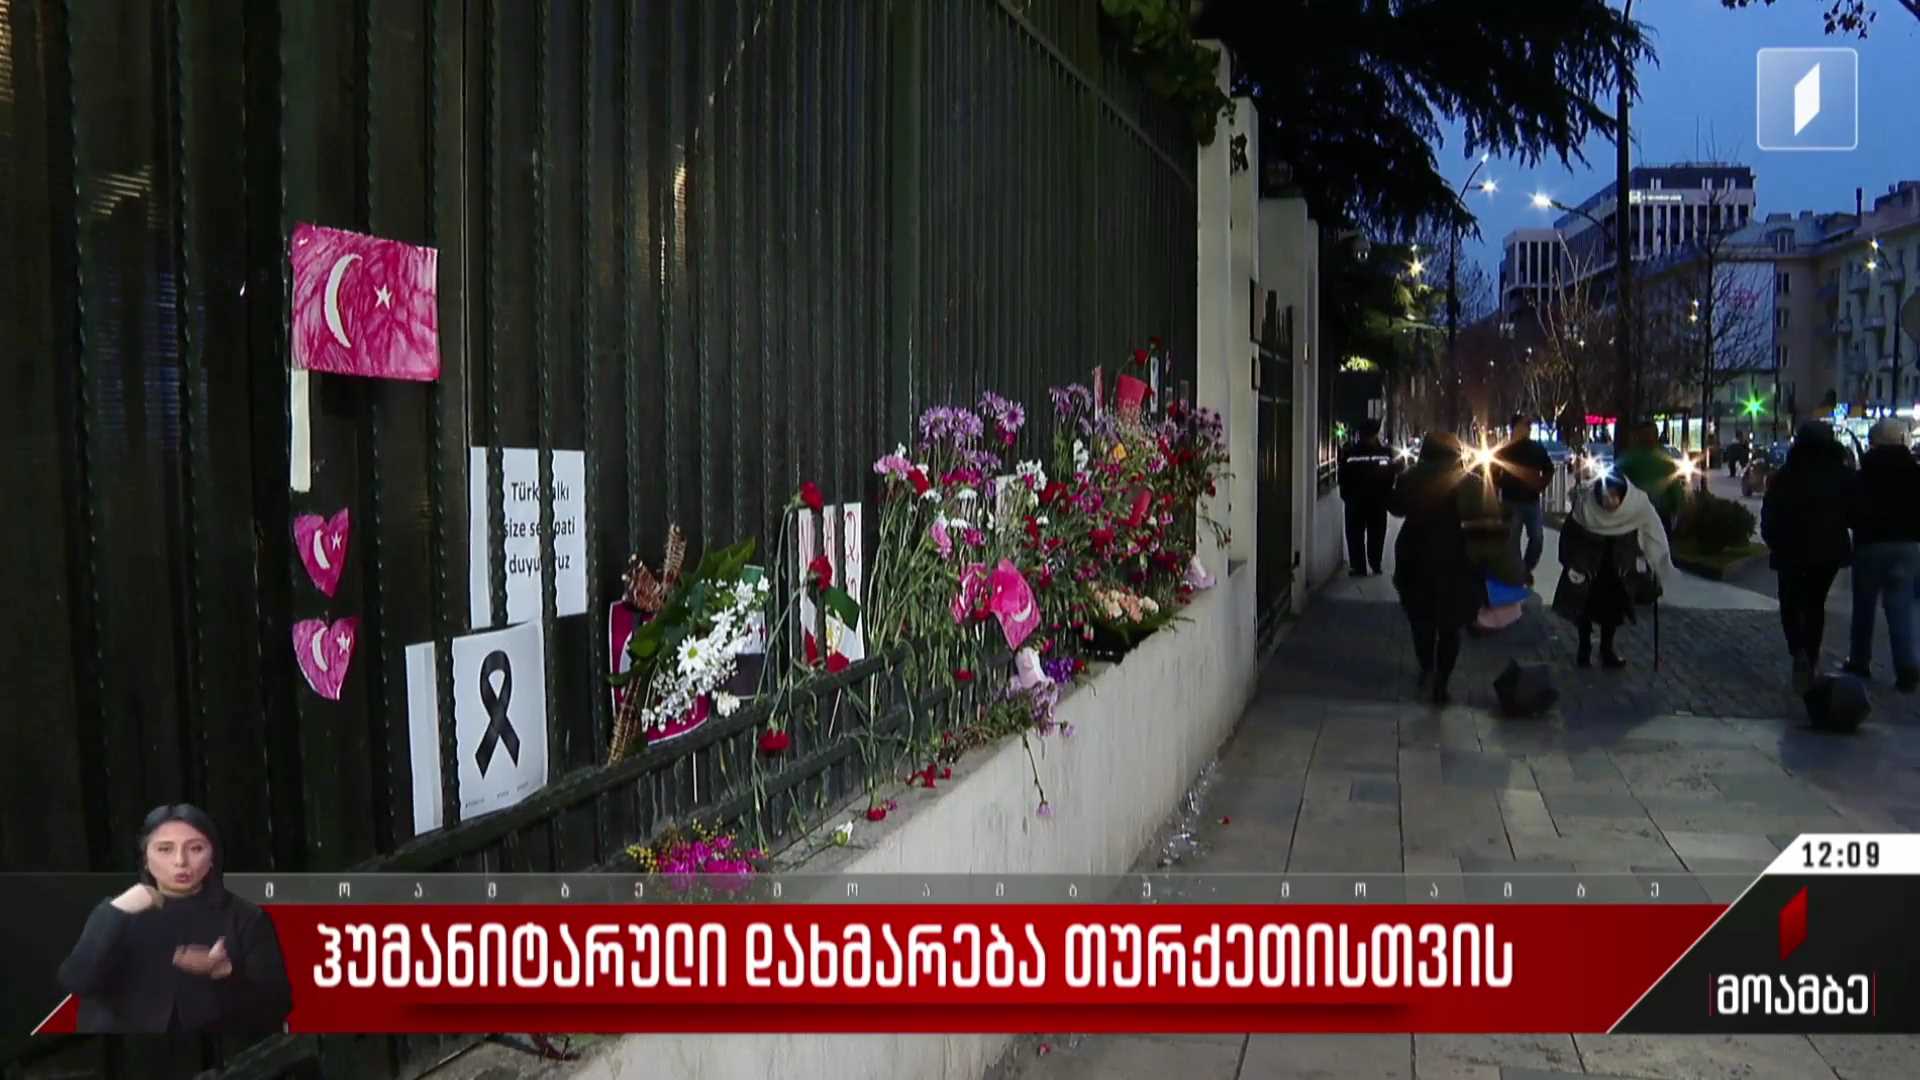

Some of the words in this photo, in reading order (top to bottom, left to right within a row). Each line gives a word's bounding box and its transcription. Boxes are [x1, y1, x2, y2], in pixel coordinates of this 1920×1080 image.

[511, 481, 541, 501] Türk
[504, 518, 527, 538] size
[530, 516, 576, 539] sepati
